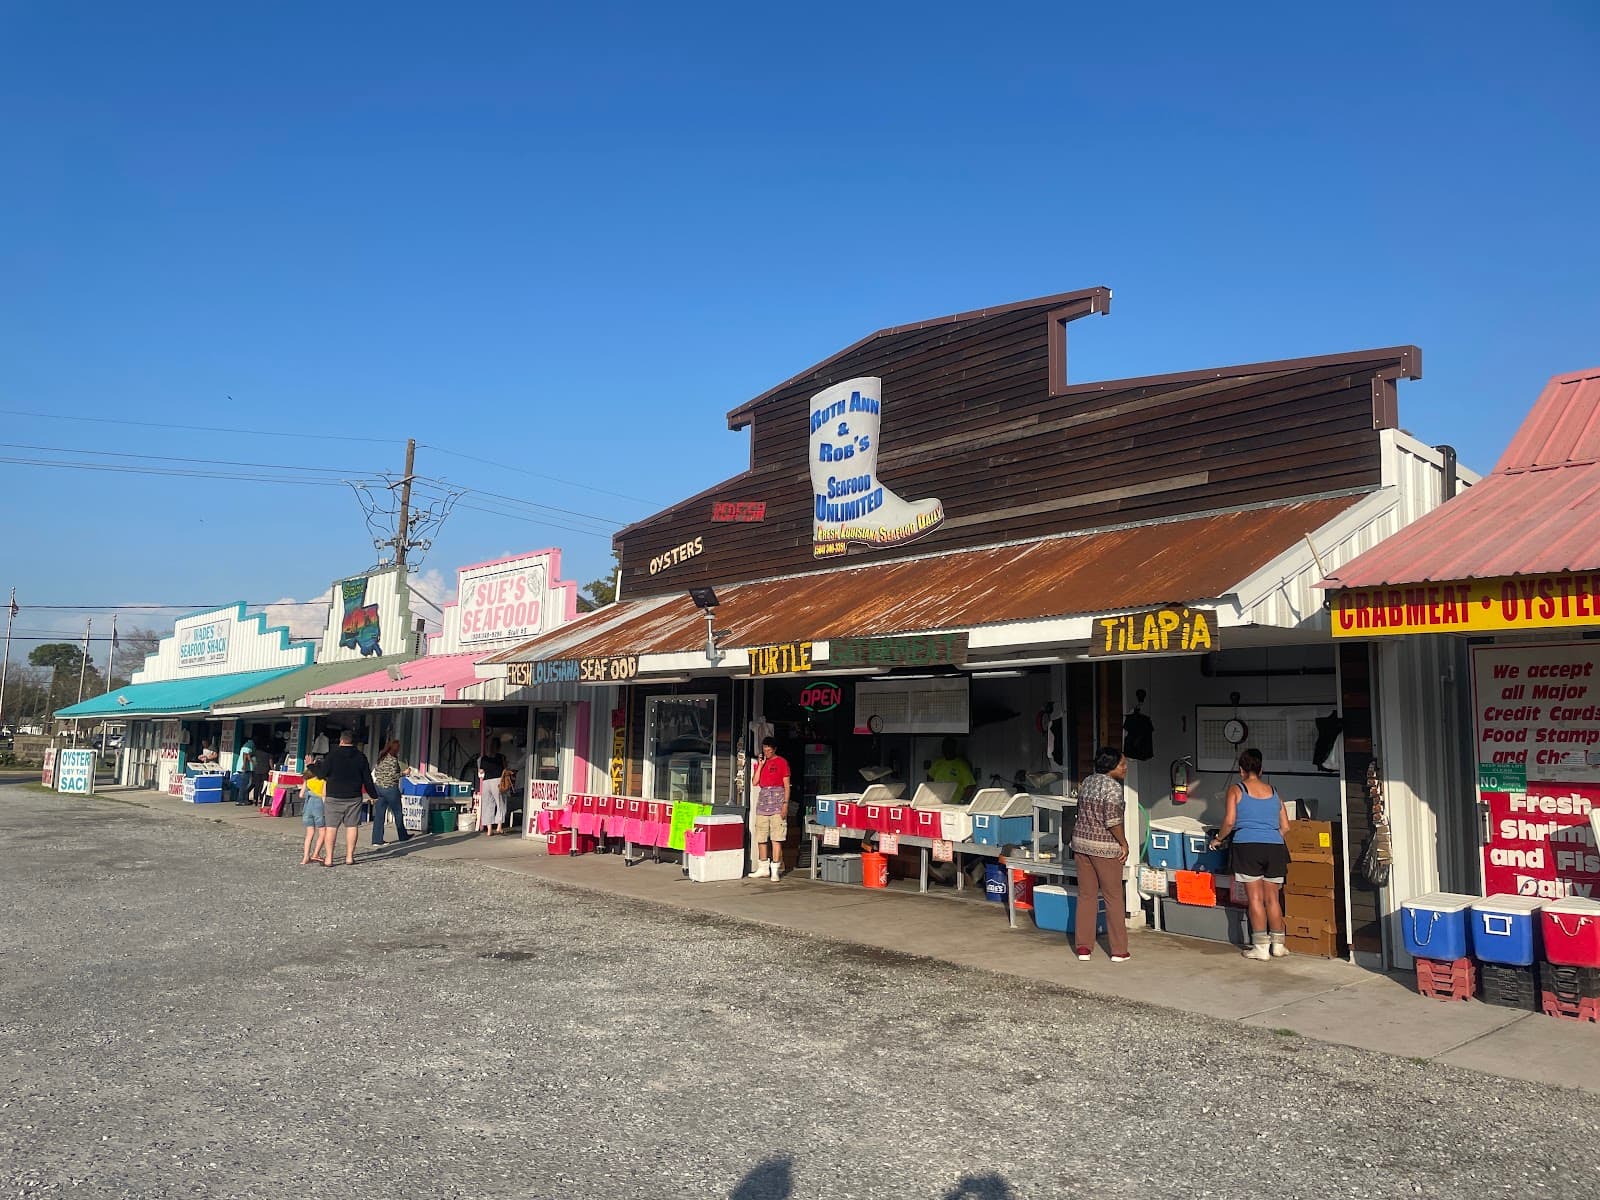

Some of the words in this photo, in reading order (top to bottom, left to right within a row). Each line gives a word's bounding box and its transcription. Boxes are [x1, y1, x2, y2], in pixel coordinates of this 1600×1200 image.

[849, 391, 879, 415] ANN
[837, 422, 850, 437] &
[827, 474, 871, 499] SEAFOOD
[815, 487, 883, 522] UNLIMITED
[649, 535, 703, 576] OYSTERS
[475, 575, 527, 607] SUE'S
[462, 600, 540, 634] SEAFOOD
[1339, 584, 1472, 630] CRABMEAT
[180, 641, 206, 658] SEAFOOD
[206, 637, 227, 654] SHACK
[747, 641, 812, 676] TURTLE
[507, 661, 532, 686] FRESH
[1492, 664, 1520, 679] We
[1527, 661, 1593, 679] accept
[800, 687, 841, 707] OPEN
[1501, 684, 1526, 700] all
[1531, 684, 1588, 702] Major
[1483, 706, 1541, 721] Credit
[1482, 727, 1528, 743] Food
[1492, 749, 1528, 764] and
[1480, 776, 1498, 788] NO
[1509, 792, 1592, 815] Fresh
[1490, 847, 1545, 869] and
